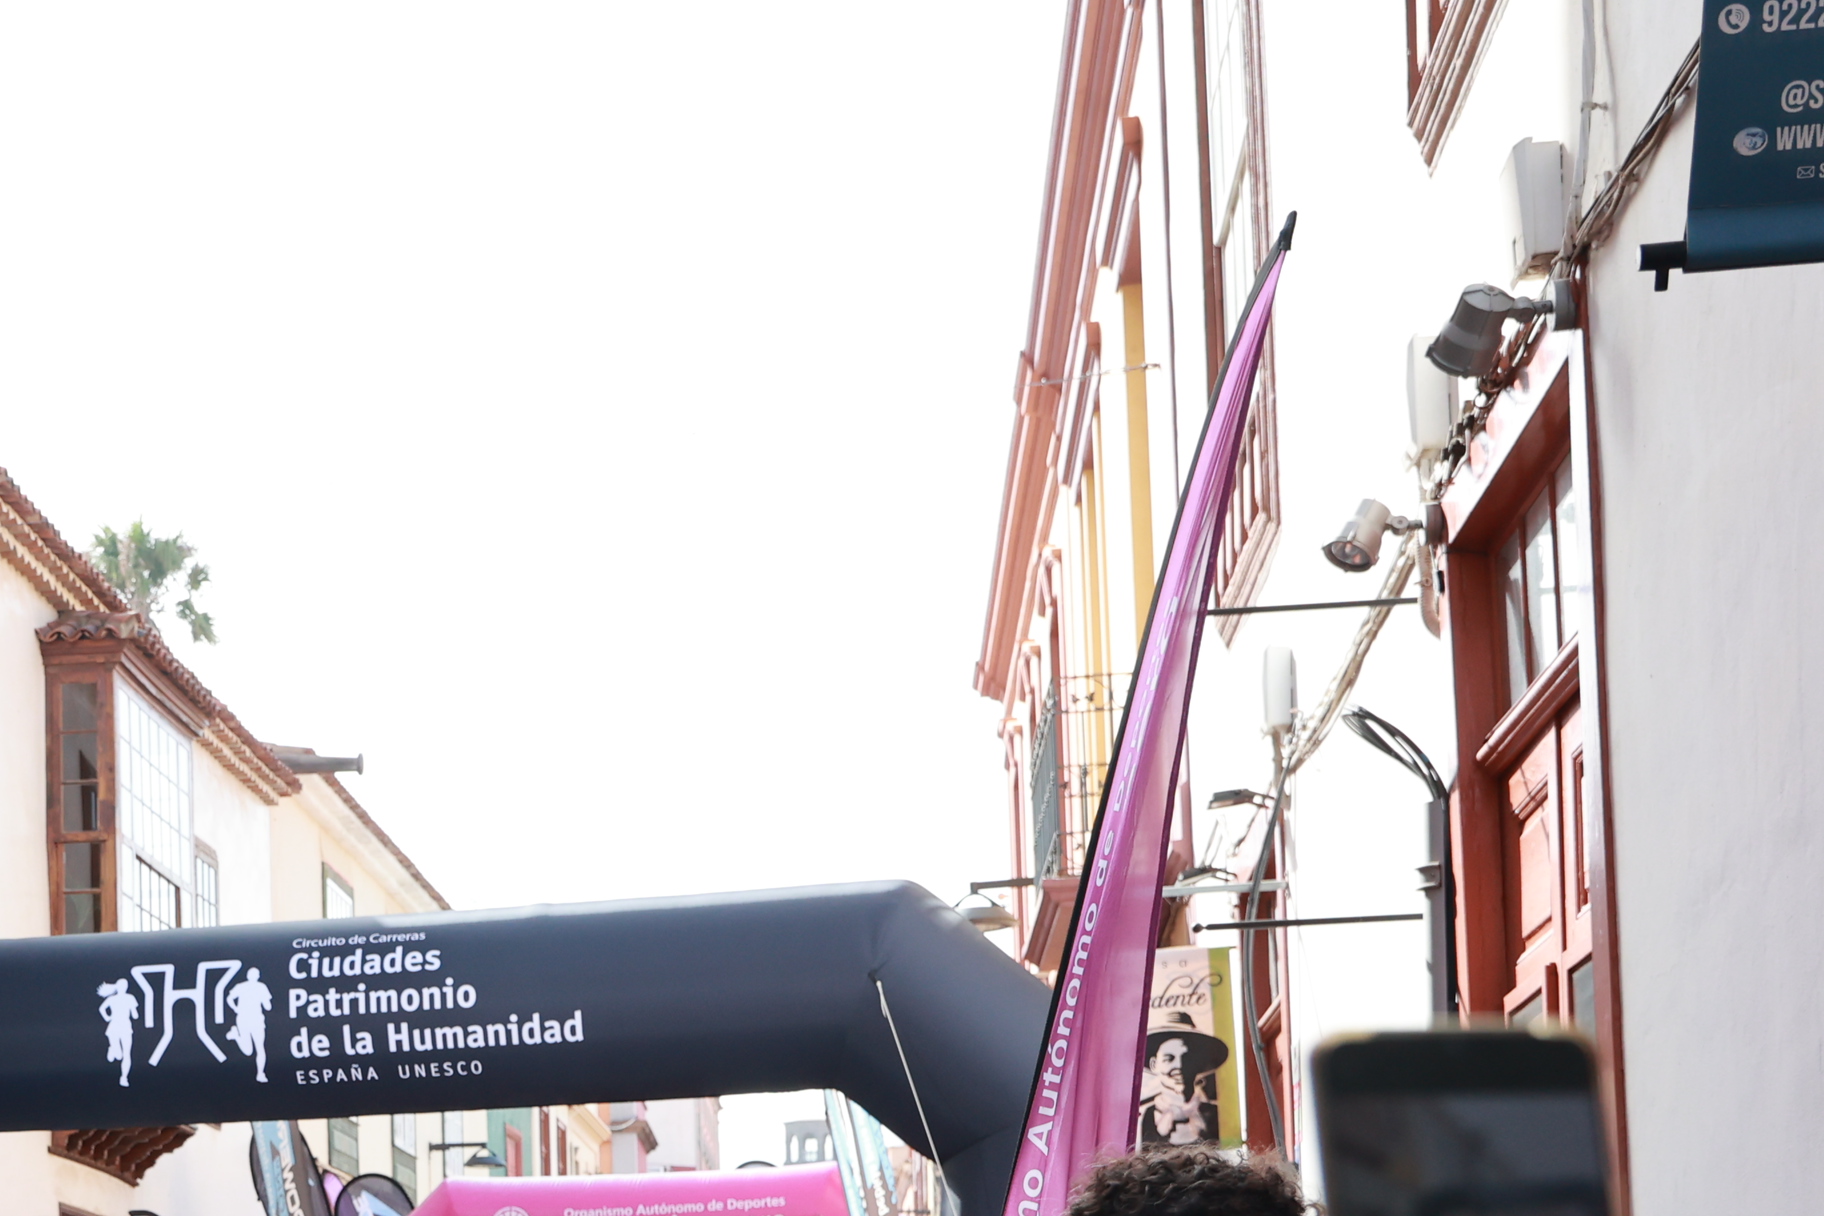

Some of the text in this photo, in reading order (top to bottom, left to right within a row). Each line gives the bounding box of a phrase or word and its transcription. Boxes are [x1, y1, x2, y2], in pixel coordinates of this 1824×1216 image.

[292, 931, 426, 949] Circuito de Carreras
[288, 945, 441, 980] Ciudades
[288, 976, 477, 1019] Patrimonio
[1027, 902, 1098, 1157] Autónomo
[1095, 829, 1115, 887] de
[290, 1009, 584, 1059] de la Humanidad
[296, 1060, 483, 1084] ESPAÑA UNESCO
[636, 1200, 705, 1216] Autónomo
[707, 1198, 724, 1212] de
[727, 1195, 786, 1212] Deportes
